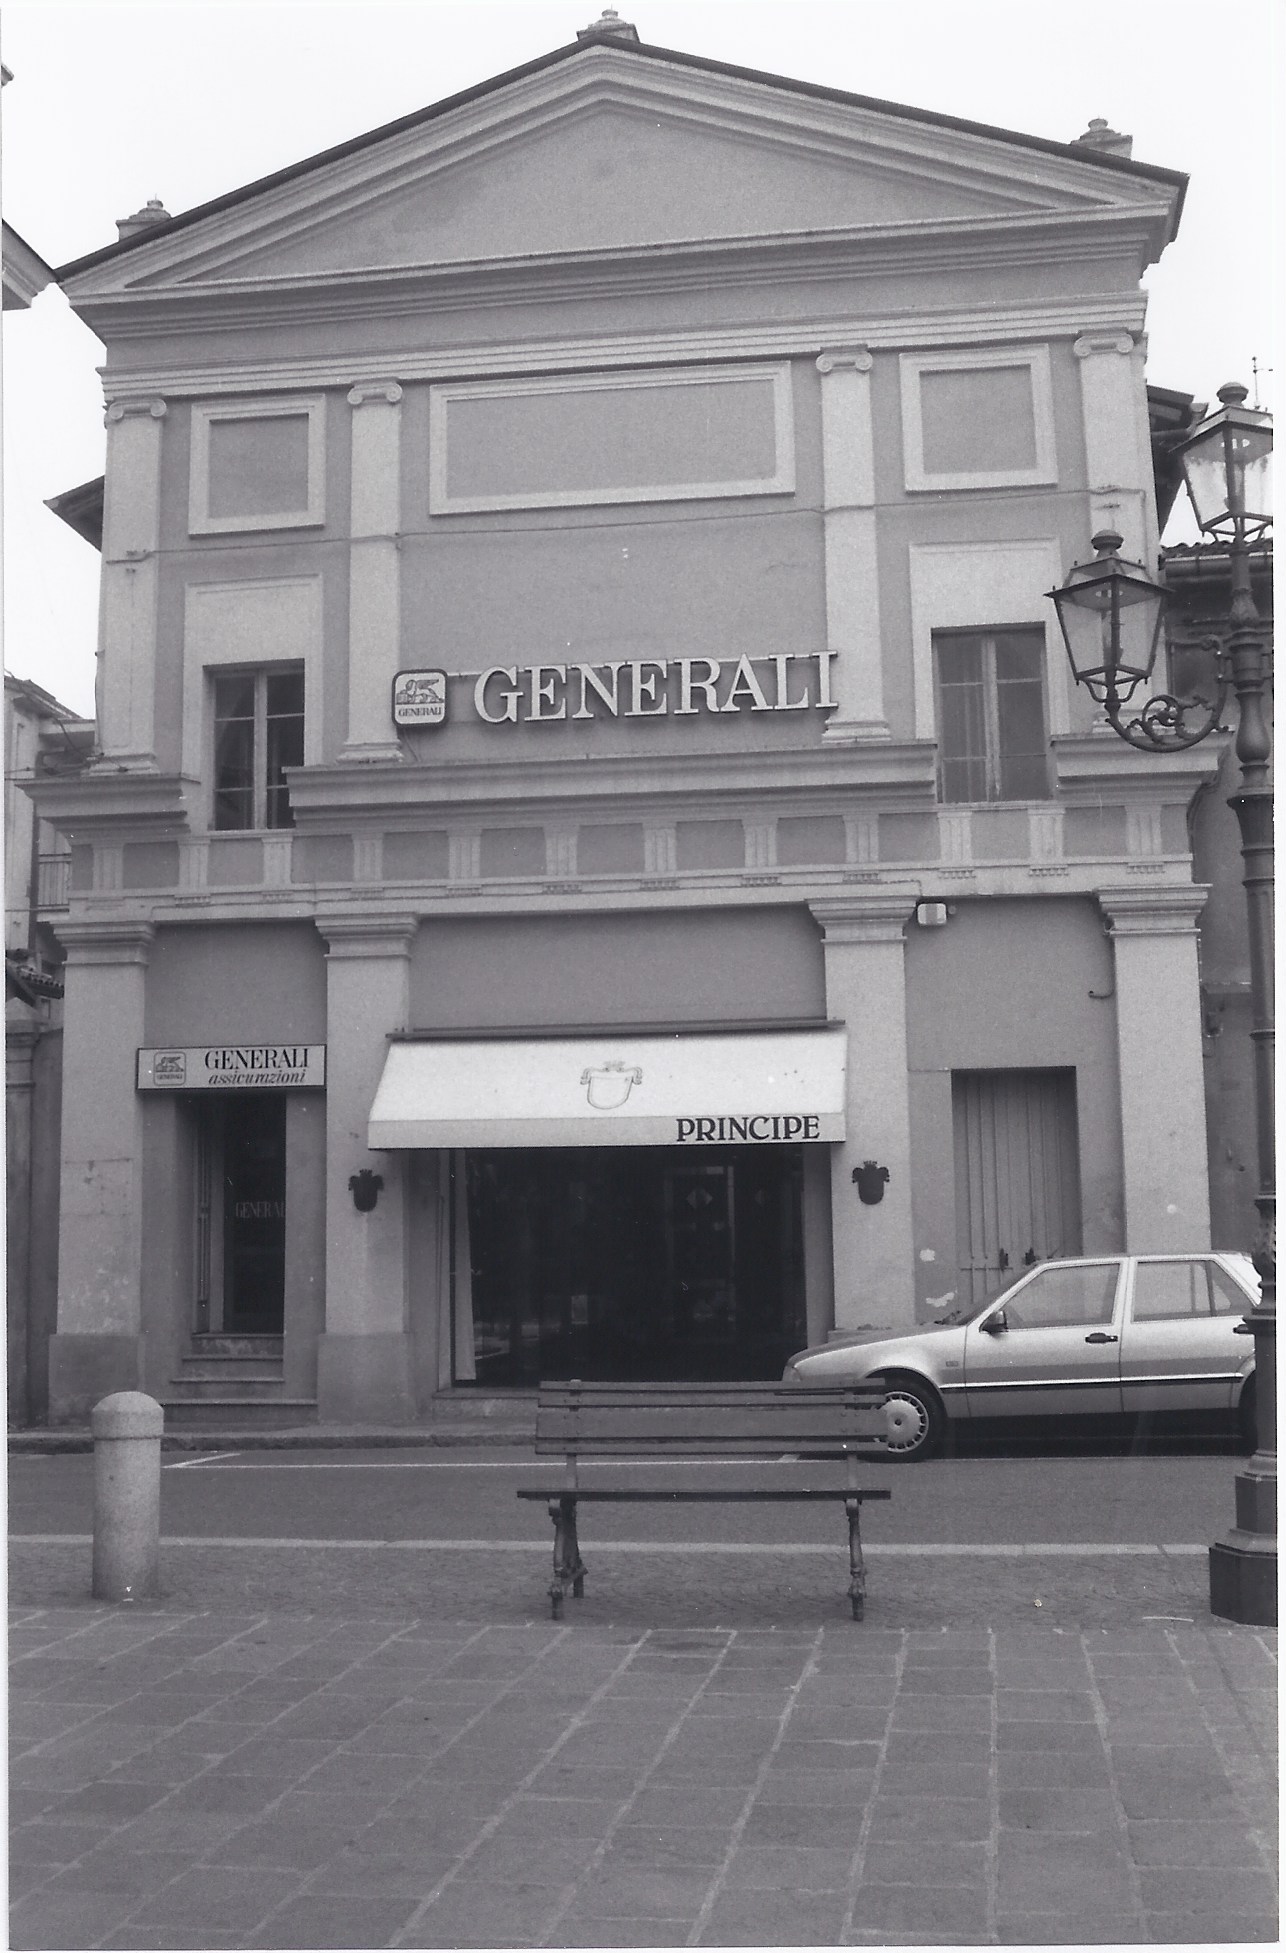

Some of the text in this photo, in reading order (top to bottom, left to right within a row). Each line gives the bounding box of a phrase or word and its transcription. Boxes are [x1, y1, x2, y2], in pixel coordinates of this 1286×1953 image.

[473, 650, 839, 724] GENERALI
[204, 1048, 310, 1070] GENERALI
[208, 1069, 307, 1085] assicurazioni
[676, 1115, 821, 1142] PRINCIPE
